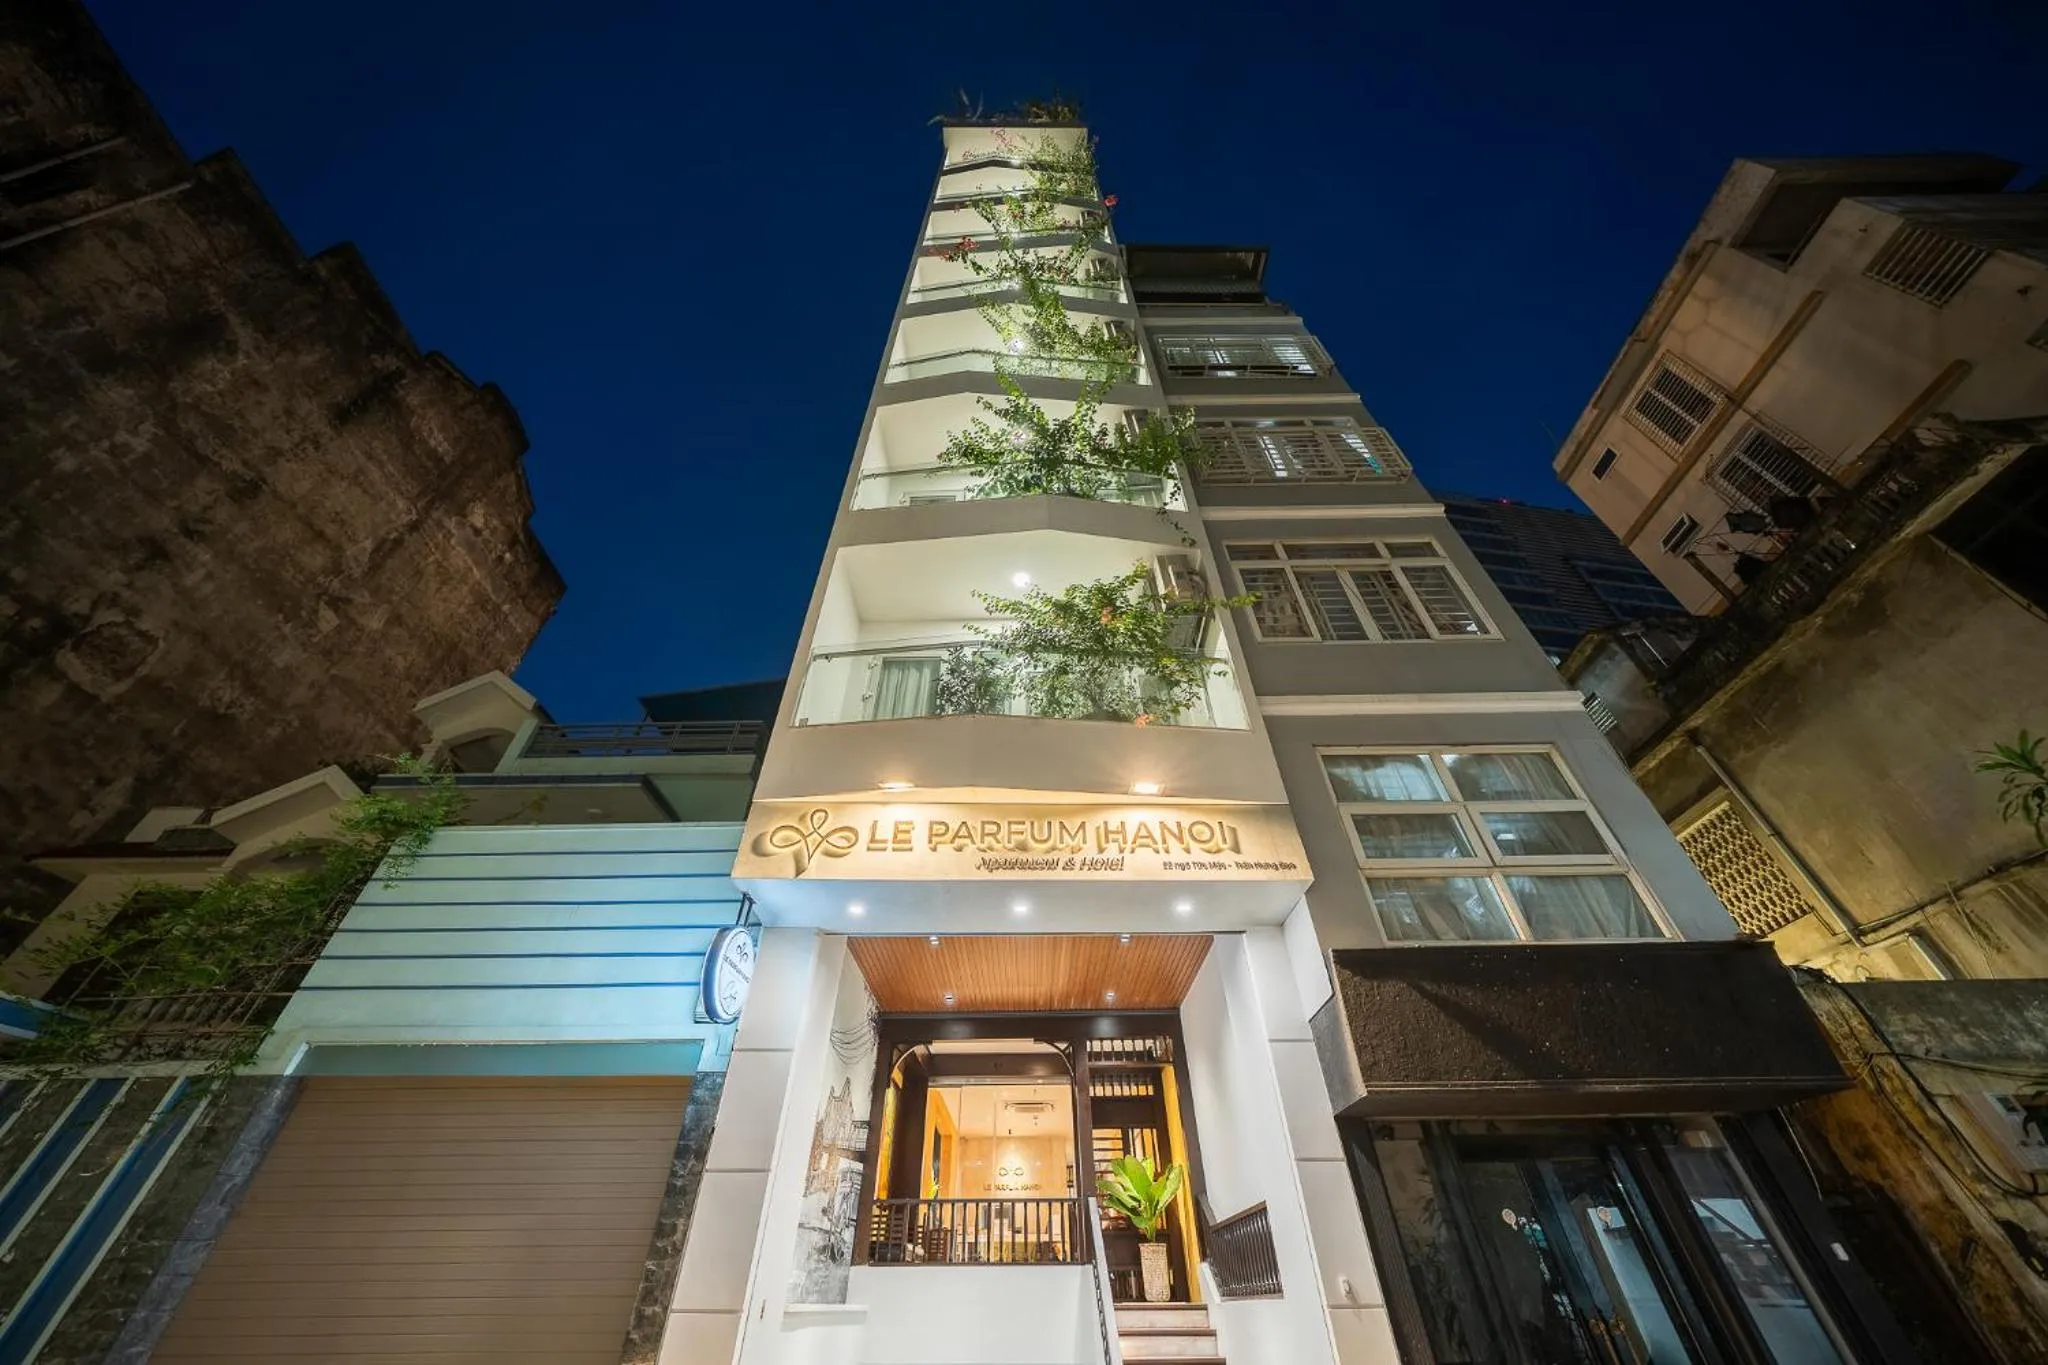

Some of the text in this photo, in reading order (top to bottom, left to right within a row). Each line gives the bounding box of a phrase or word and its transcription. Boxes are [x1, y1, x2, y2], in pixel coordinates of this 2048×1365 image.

[868, 819, 1229, 848] LE PARFUM HANOI
[1062, 857, 1076, 871] &
